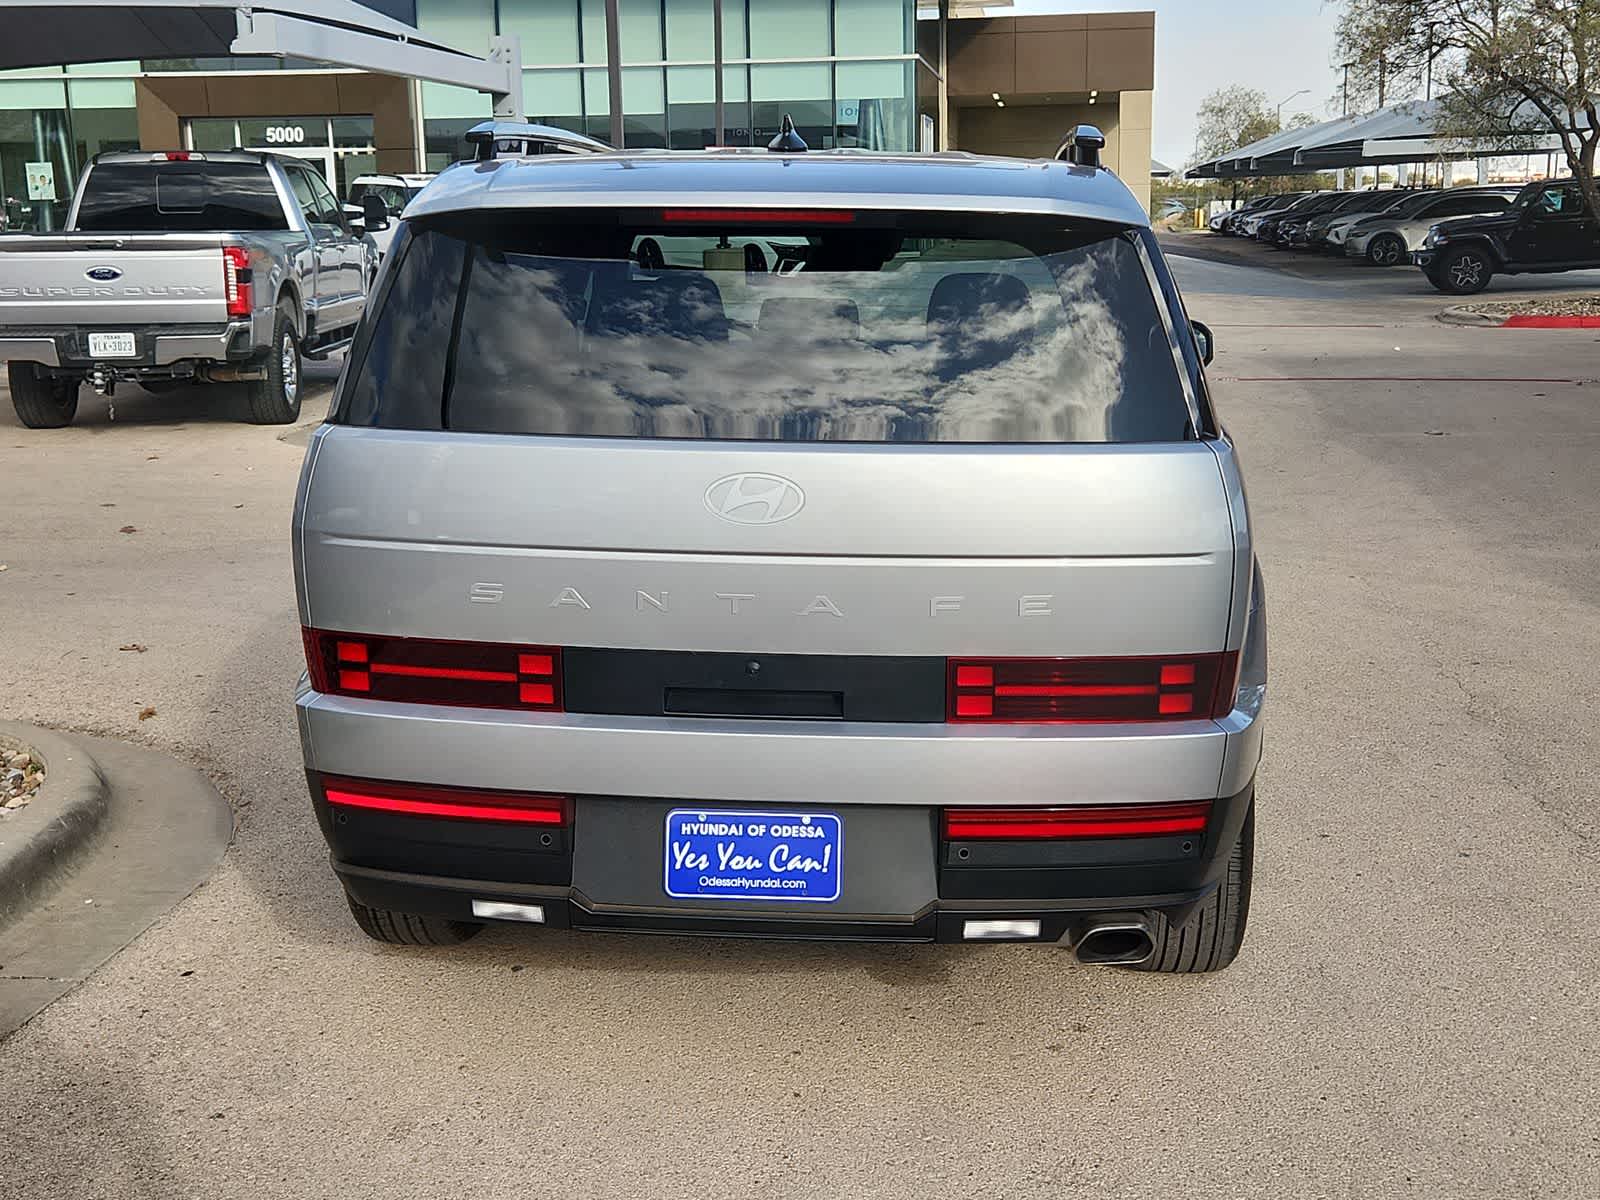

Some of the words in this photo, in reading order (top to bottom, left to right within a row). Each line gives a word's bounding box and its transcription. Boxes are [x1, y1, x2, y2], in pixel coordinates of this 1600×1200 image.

[266, 126, 304, 143] 5000
[0, 282, 114, 297] SUPER
[123, 282, 211, 296] DUTY
[470, 581, 845, 617] SANTA
[928, 593, 1054, 617] FE
[681, 823, 743, 836] HYUNDAI
[747, 824, 766, 837] OF
[770, 825, 825, 838] ODESSA
[672, 841, 710, 870] Yes
[717, 842, 763, 870] You
[768, 844, 832, 873] Can!
[699, 875, 807, 889] OdessaHyundai.com
